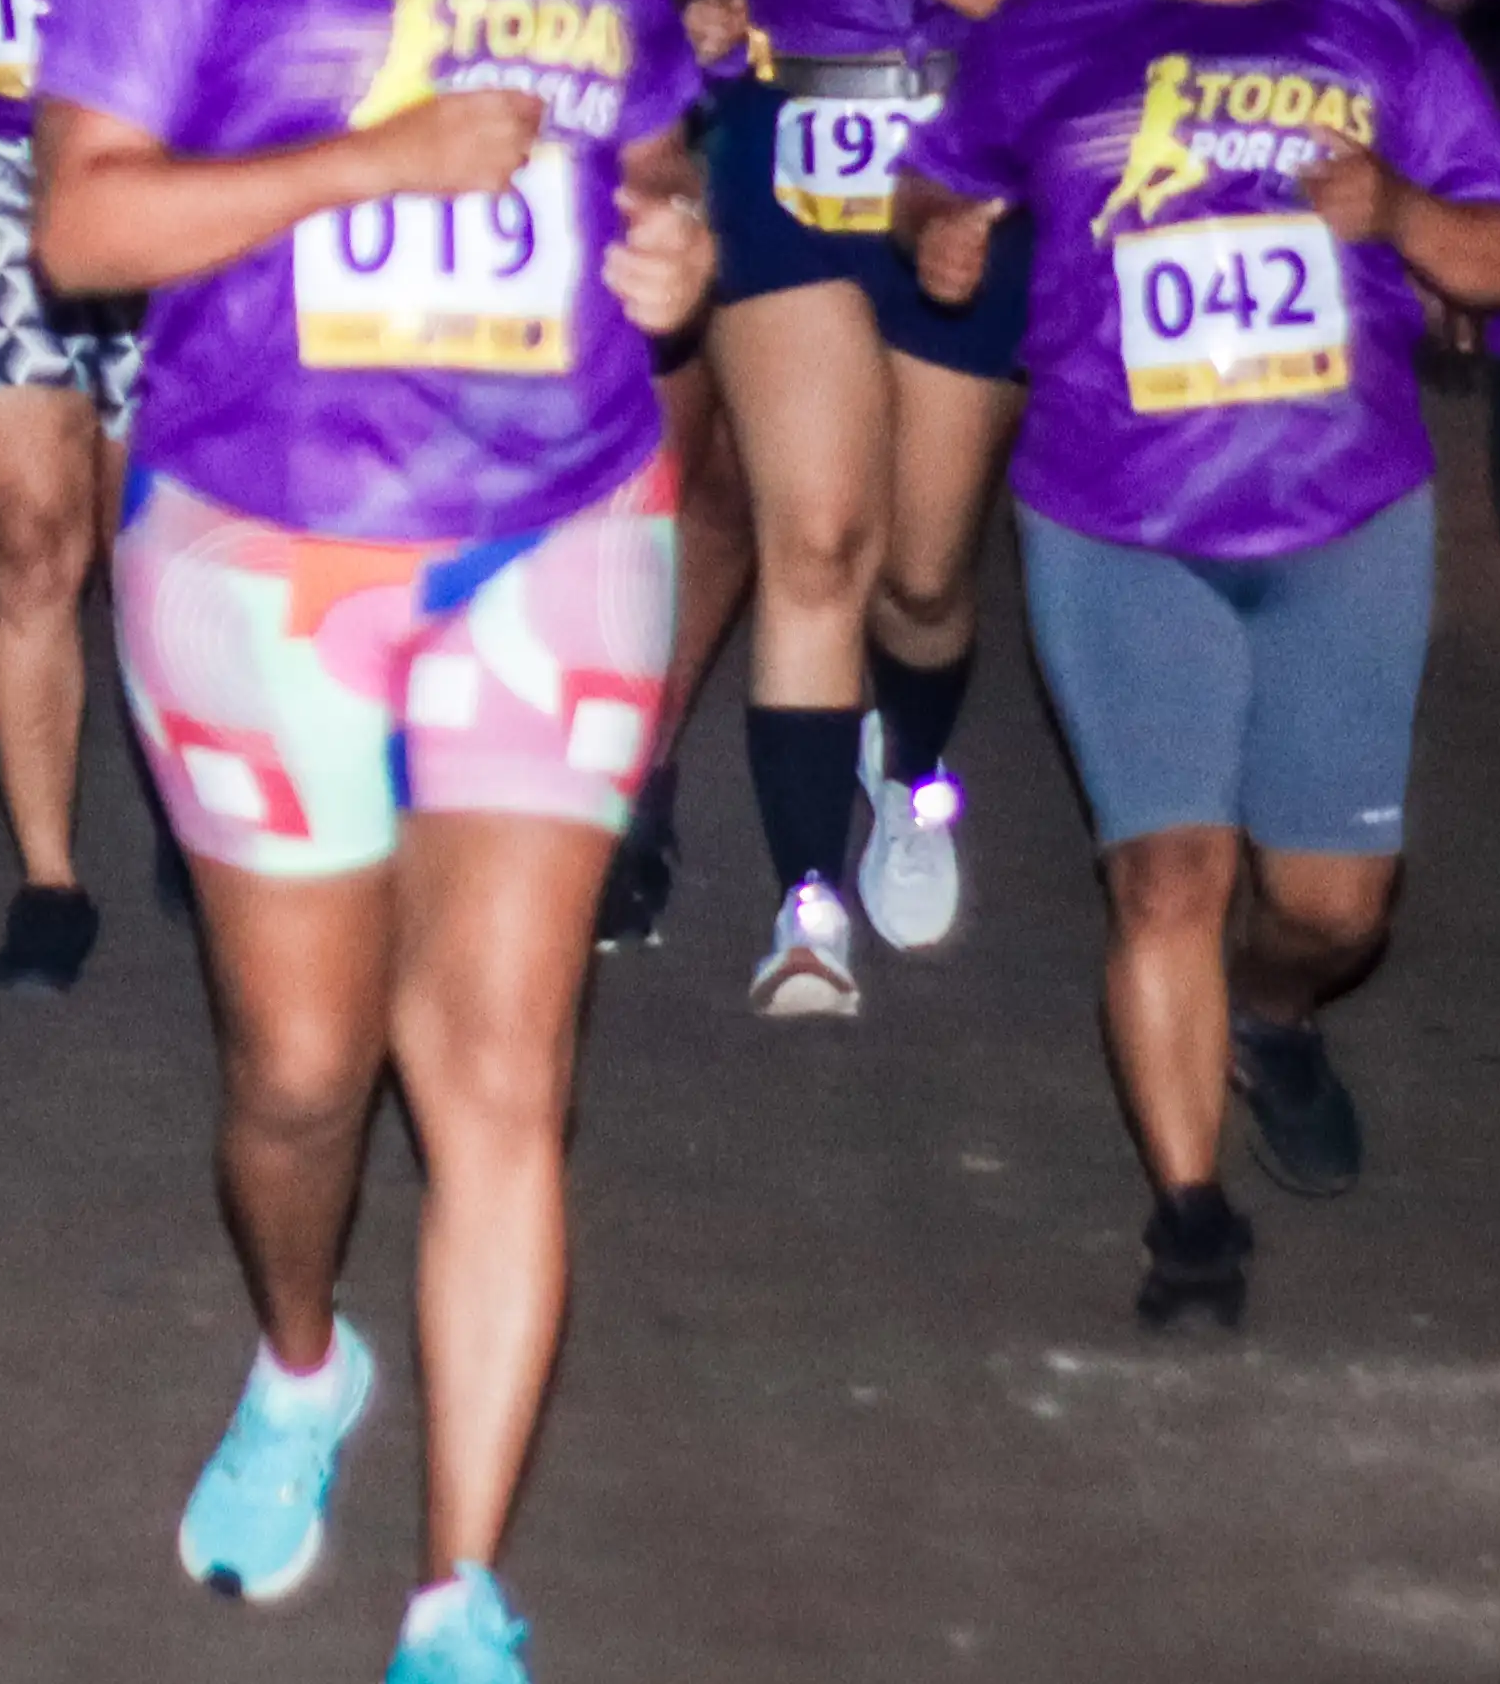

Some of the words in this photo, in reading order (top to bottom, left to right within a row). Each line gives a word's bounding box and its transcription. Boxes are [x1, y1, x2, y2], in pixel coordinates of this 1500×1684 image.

[1185, 130, 1275, 171] POR
[1195, 73, 1373, 146] TODAS
[335, 184, 536, 278] 019
[1141, 246, 1316, 342] 042
